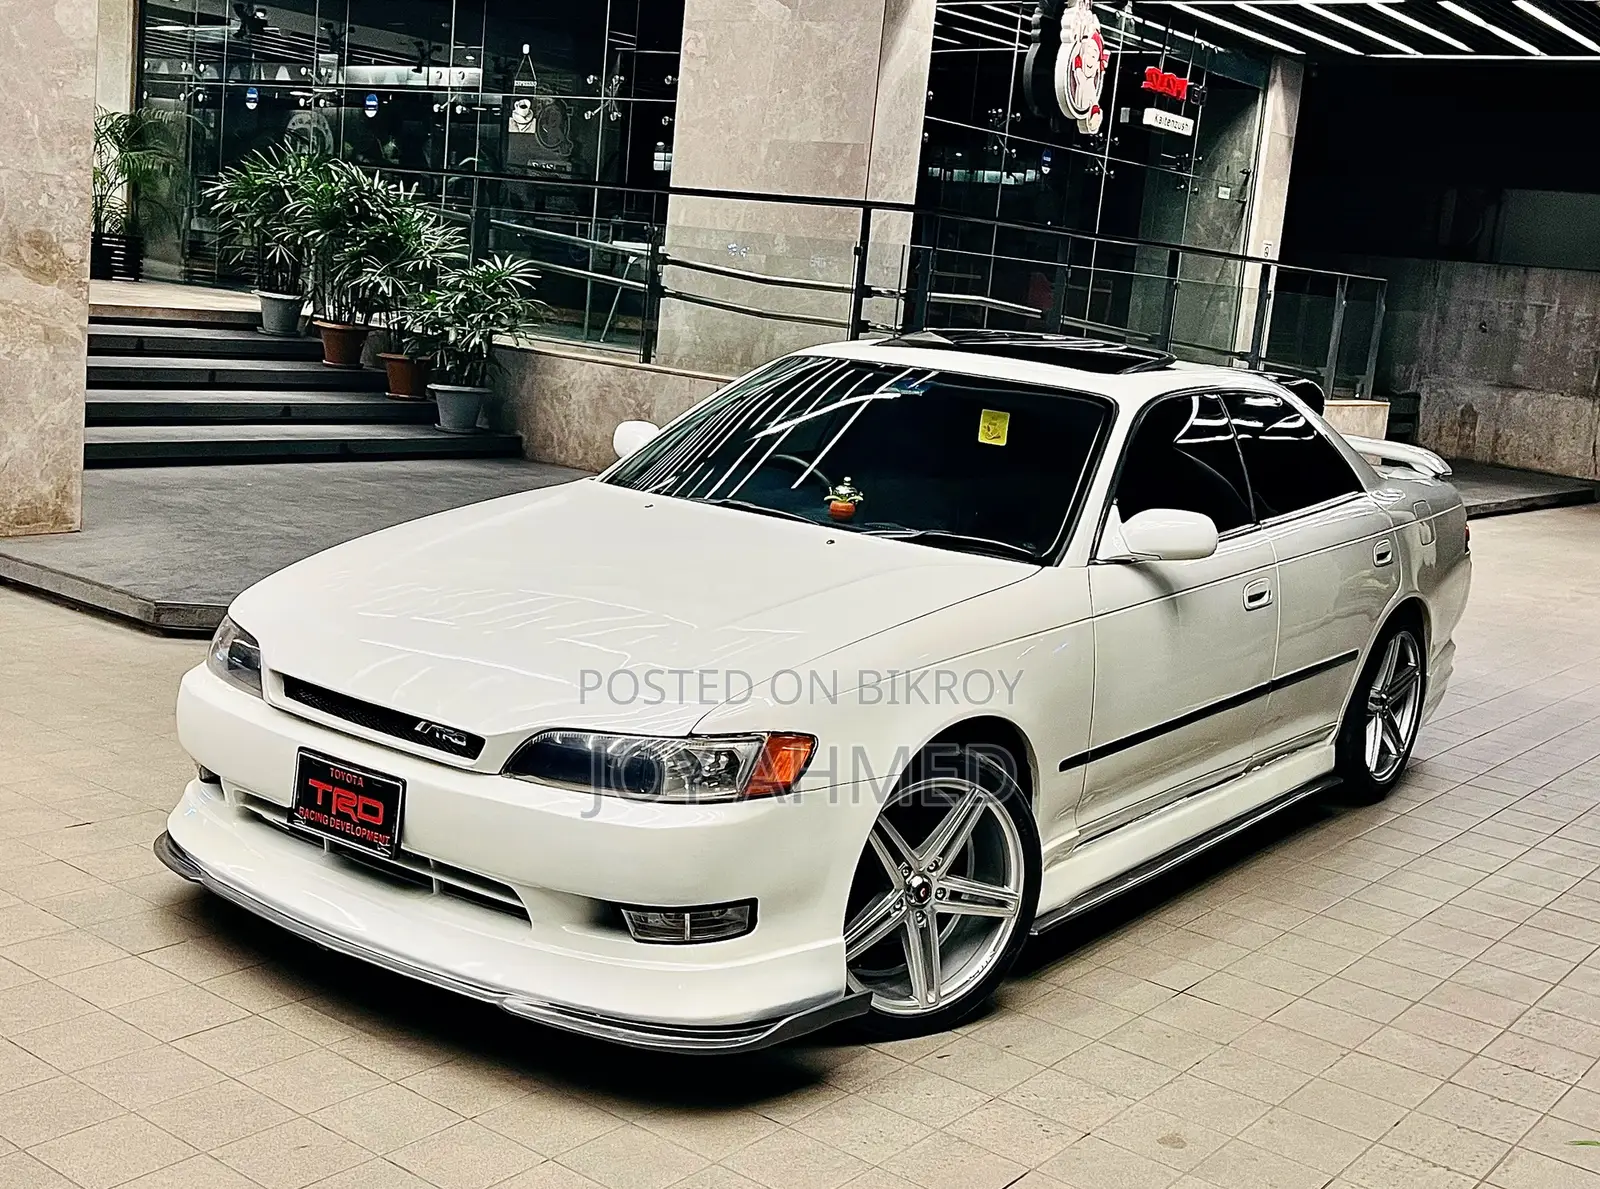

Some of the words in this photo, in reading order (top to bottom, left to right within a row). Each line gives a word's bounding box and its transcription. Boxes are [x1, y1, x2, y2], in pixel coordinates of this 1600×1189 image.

[1154, 113, 1190, 131] Kaitenzush
[329, 767, 364, 788] TOYOTA
[308, 778, 384, 825] TRD
[298, 806, 329, 826] RACING
[329, 817, 391, 847] DEVELOPMENT
